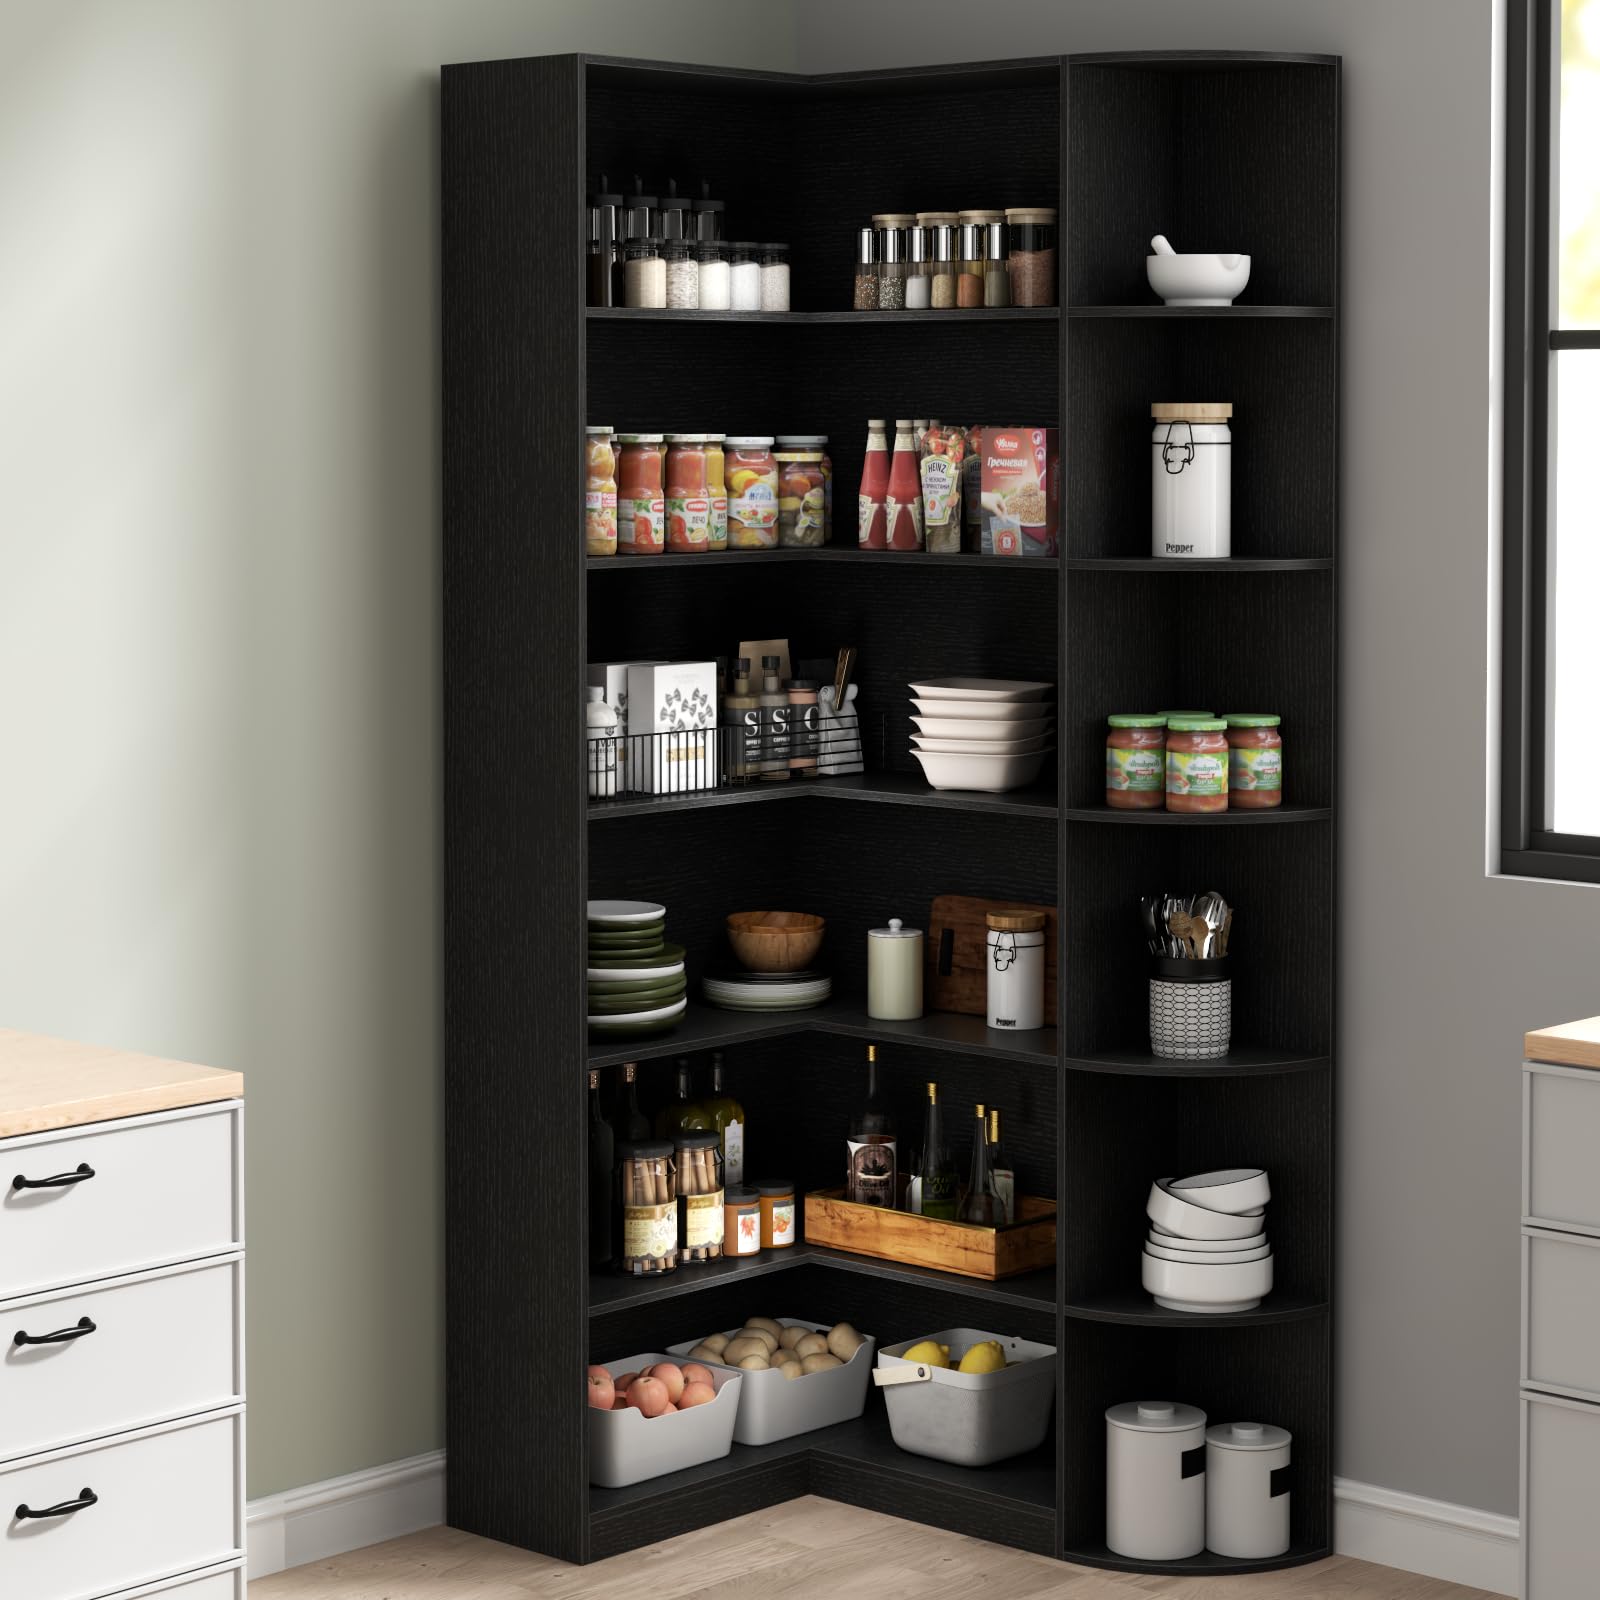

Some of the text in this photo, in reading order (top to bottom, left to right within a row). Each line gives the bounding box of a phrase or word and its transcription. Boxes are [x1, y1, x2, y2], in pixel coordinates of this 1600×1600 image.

[987, 456, 1028, 468] Гречневая
[928, 462, 947, 474] HEINZ
[691, 515, 706, 524] ЛЕЧО
[1165, 543, 1194, 554] Pepper
[995, 1018, 1017, 1028] Pepper
